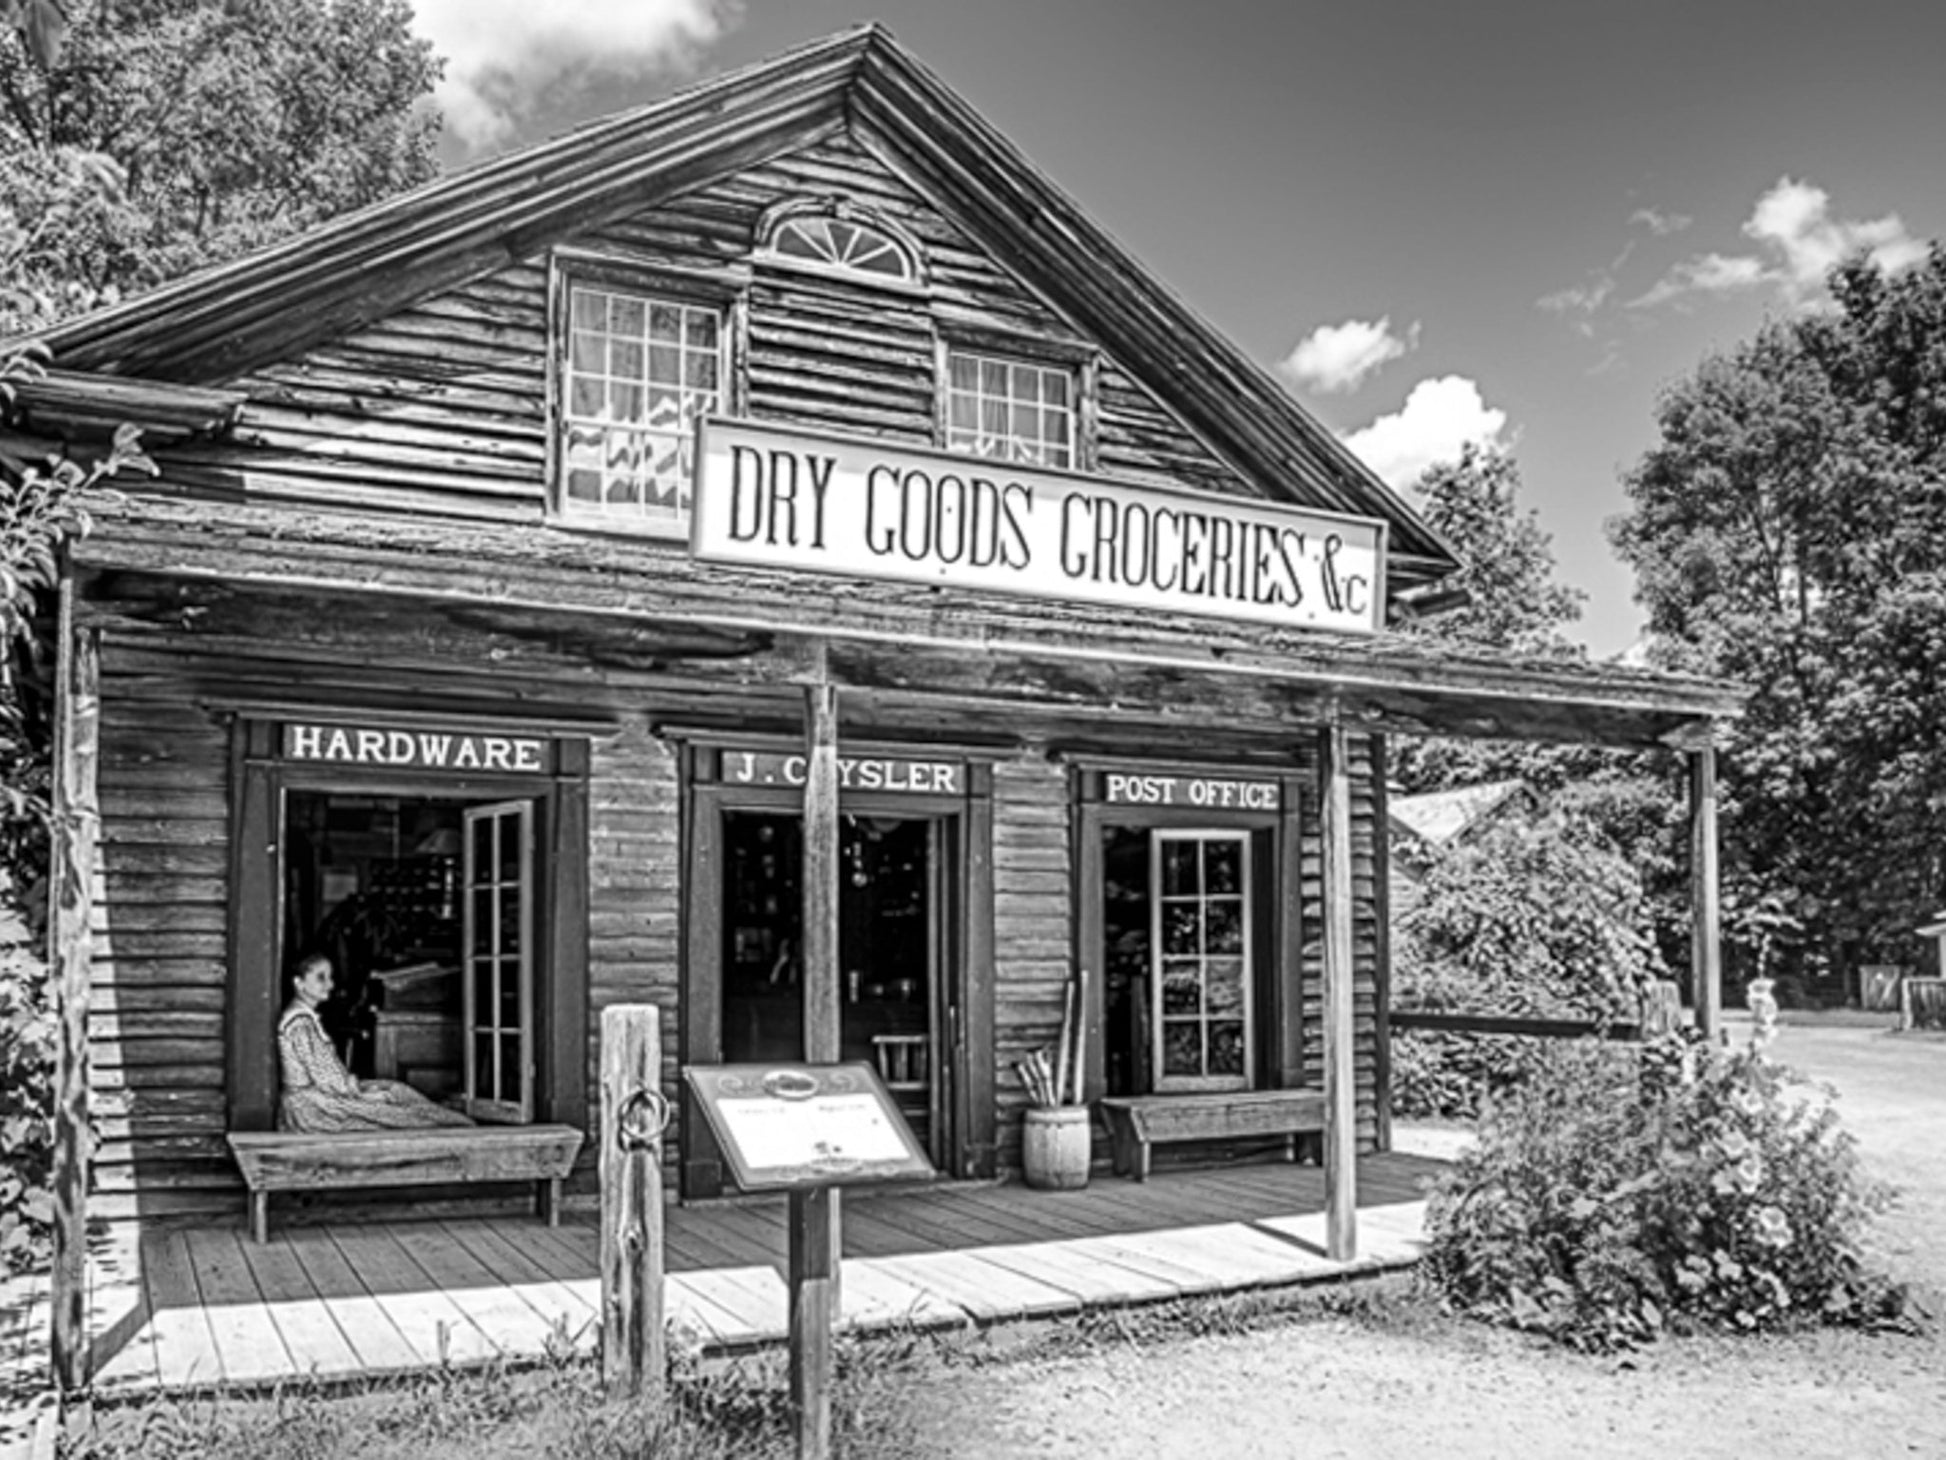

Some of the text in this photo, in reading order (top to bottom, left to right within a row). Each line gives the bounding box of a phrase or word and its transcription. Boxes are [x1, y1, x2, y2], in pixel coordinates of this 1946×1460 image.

[728, 445, 837, 549] DRY
[865, 464, 1034, 570] GOODS
[1060, 491, 1306, 608] GROCERIES
[292, 725, 542, 771] HARDWARE
[783, 756, 957, 793] CYSLER
[1107, 775, 1279, 810] POST OFFICE
